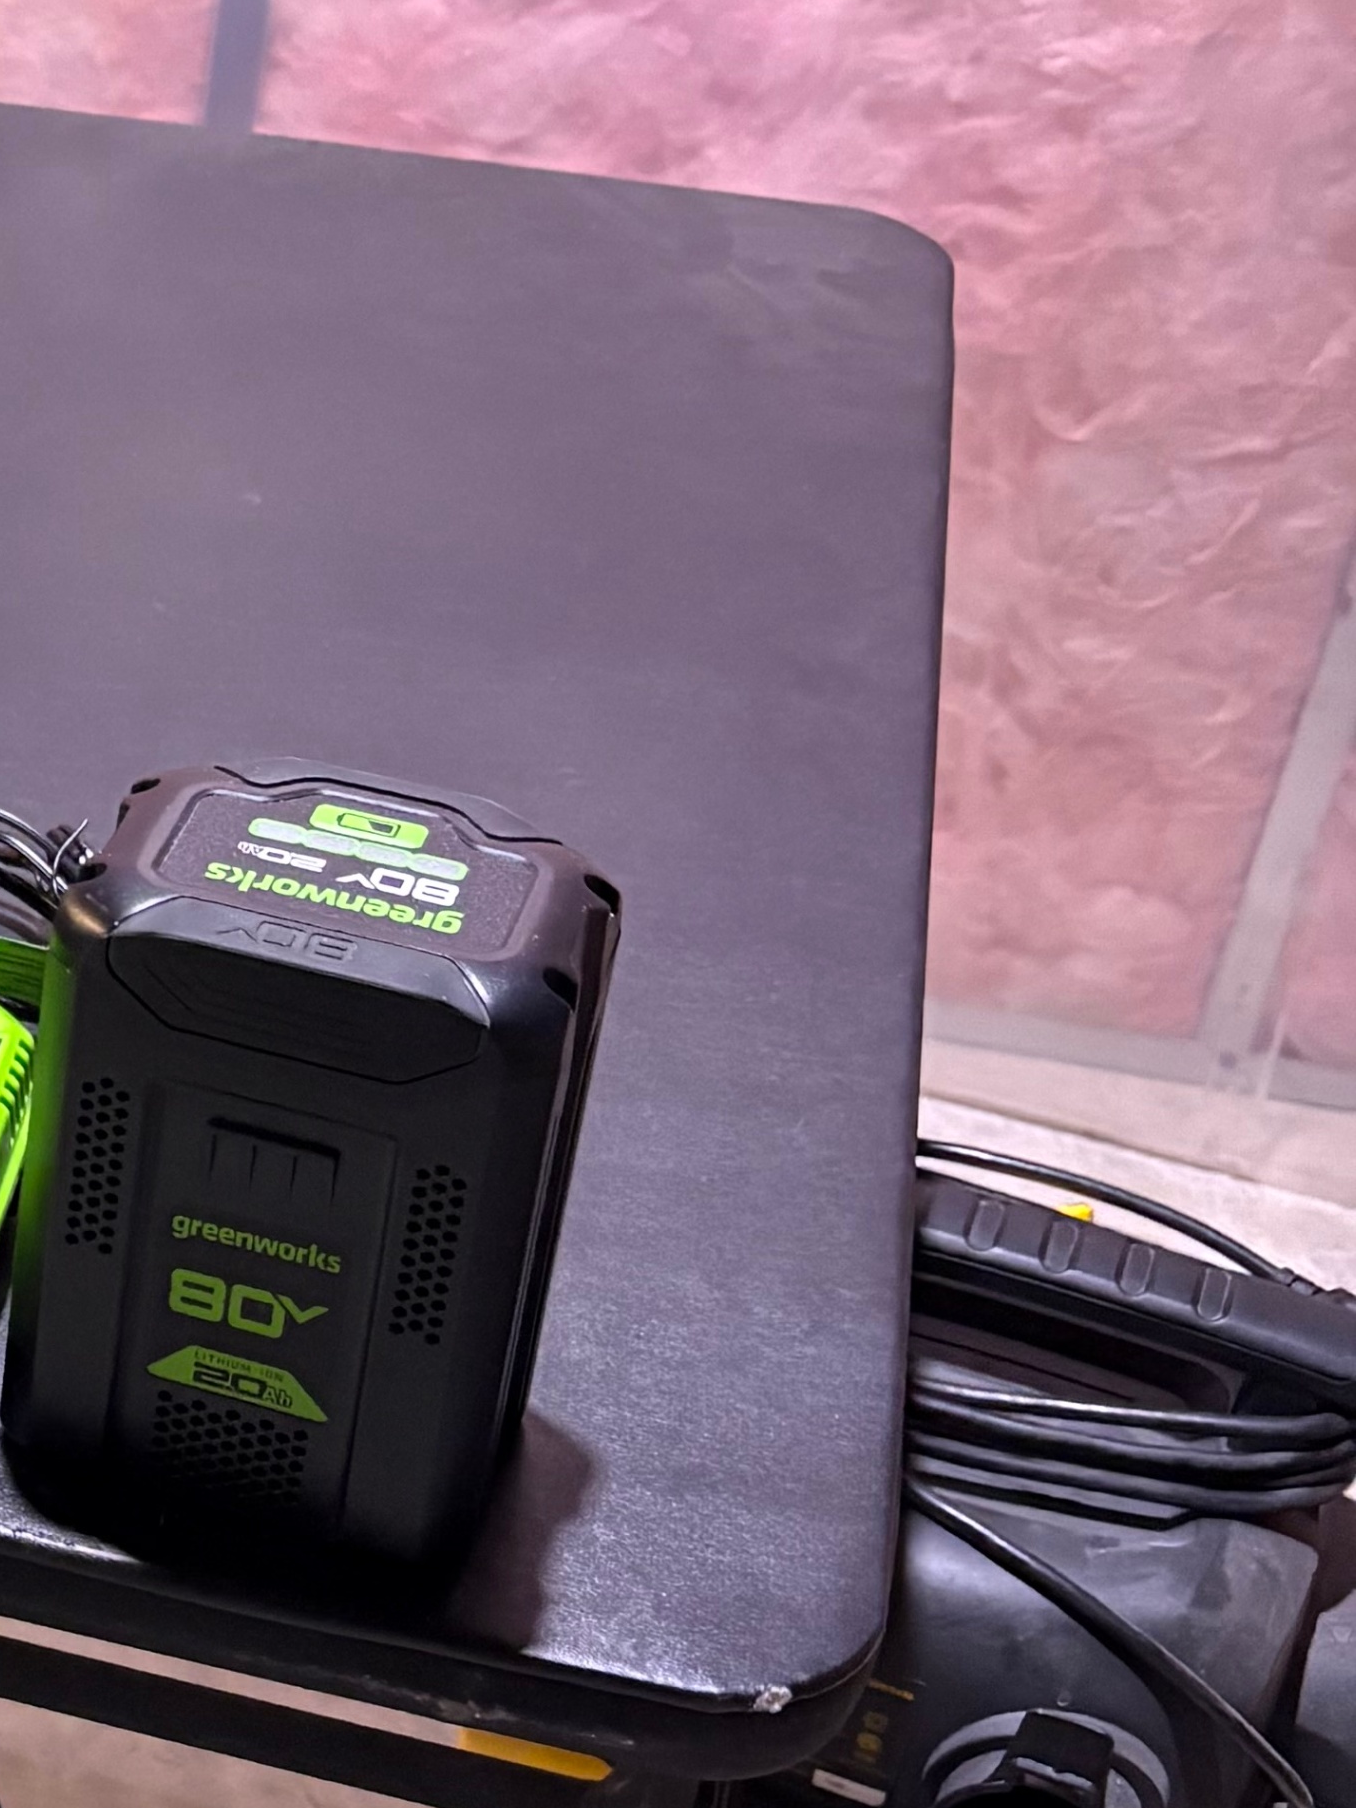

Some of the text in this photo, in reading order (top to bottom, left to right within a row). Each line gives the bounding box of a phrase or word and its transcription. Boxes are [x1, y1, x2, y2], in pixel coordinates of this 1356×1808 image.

[205, 862, 465, 934] greenworks
[335, 867, 460, 907] 80V
[172, 1215, 342, 1274] greenworks
[169, 1268, 330, 1339] 80V
